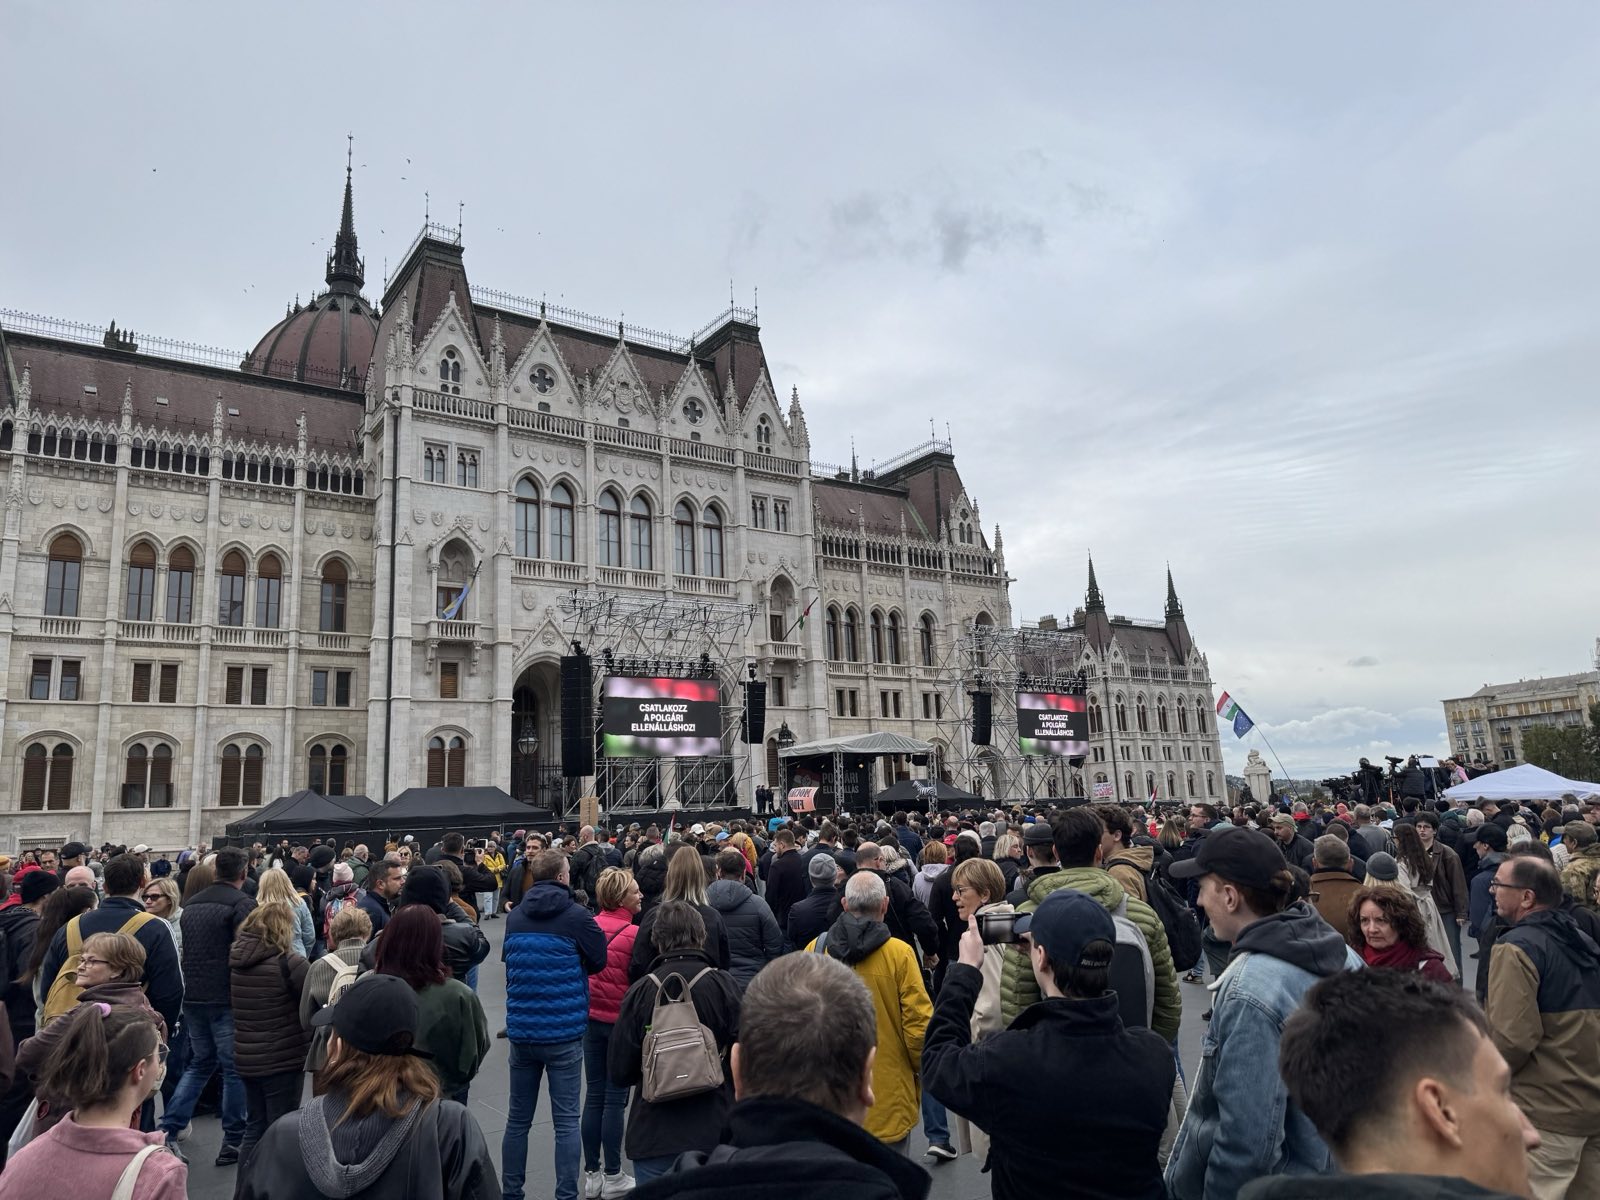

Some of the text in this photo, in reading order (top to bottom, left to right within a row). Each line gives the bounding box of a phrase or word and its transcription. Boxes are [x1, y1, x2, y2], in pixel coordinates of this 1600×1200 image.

[639, 704, 688, 712] CSATLAKOZZ
[644, 712, 684, 722] A POLGÁRI
[631, 722, 696, 732] ELLENÁLLÁSHOZ!
[822, 770, 859, 784] POÁRI
